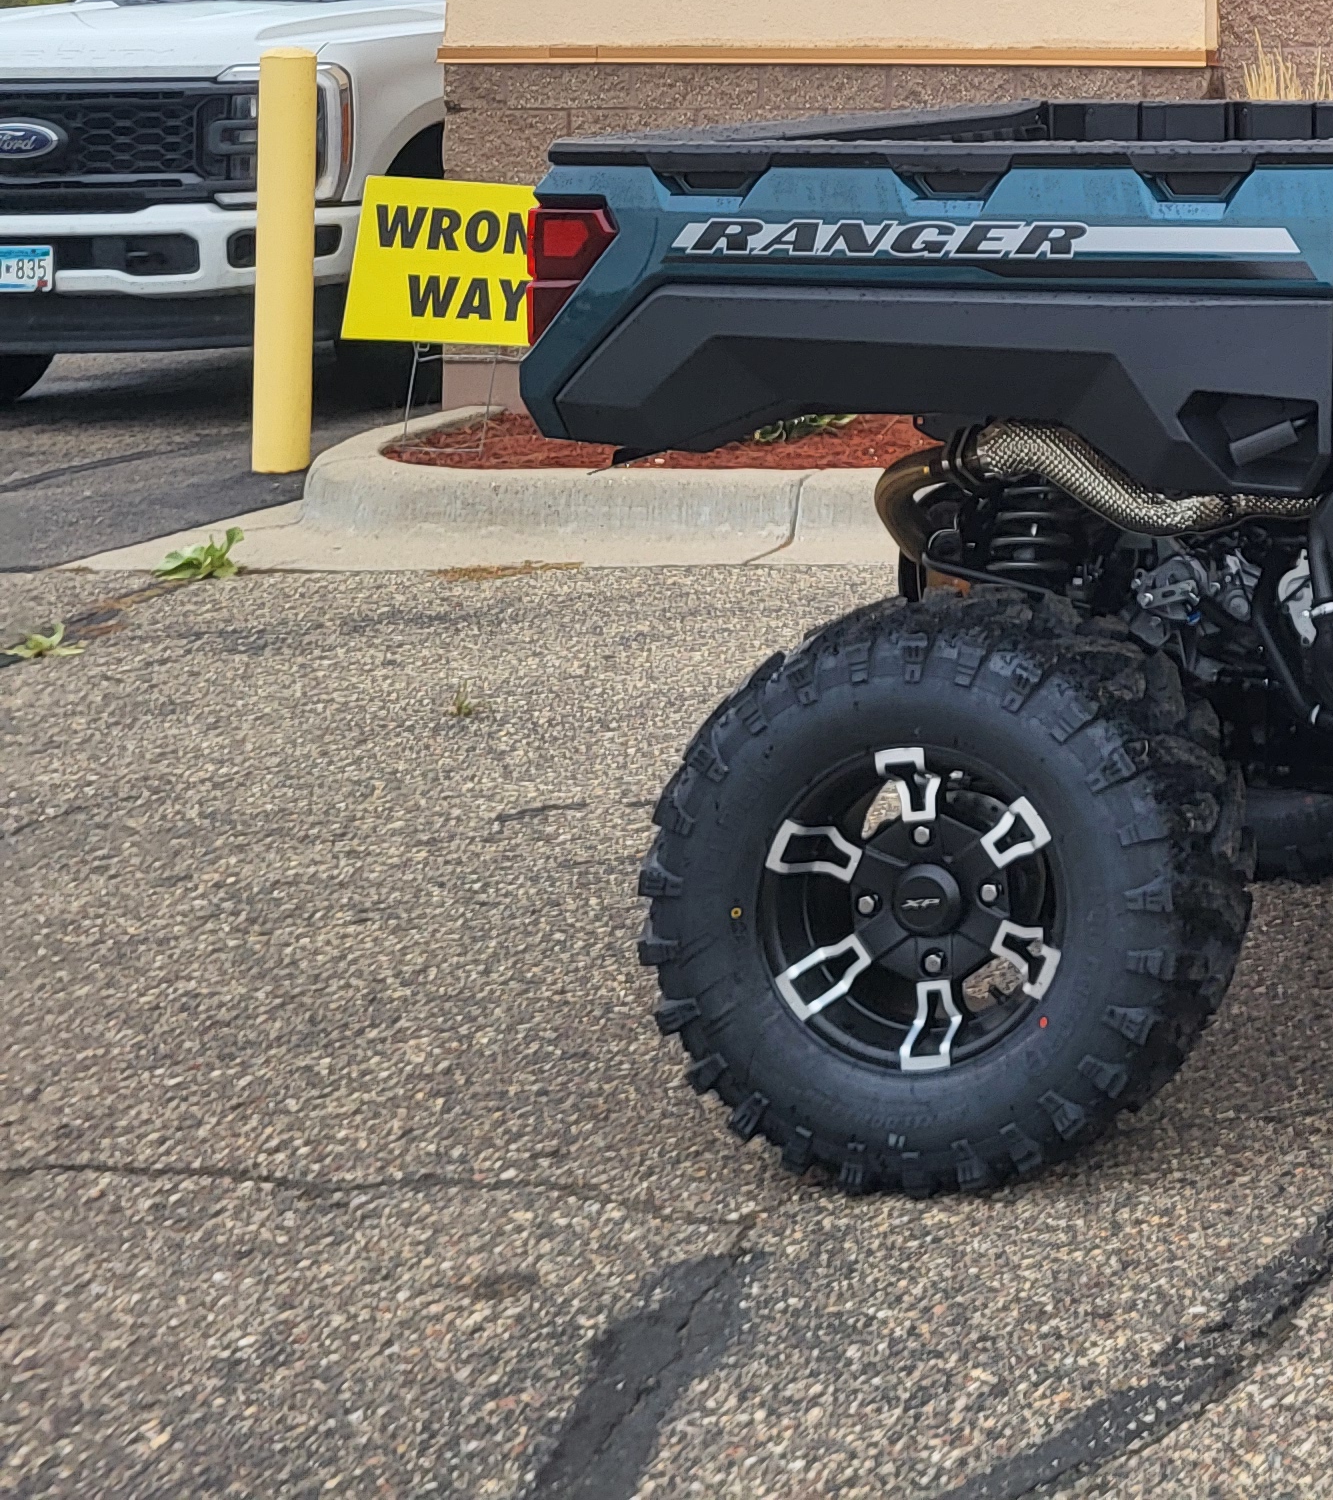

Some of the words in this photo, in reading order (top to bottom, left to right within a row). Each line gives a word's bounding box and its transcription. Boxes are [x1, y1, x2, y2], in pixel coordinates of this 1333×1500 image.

[0, 131, 37, 150] Ford
[376, 203, 527, 255] WRON
[686, 217, 1089, 260] RANGER
[407, 273, 532, 322] WAY
[901, 898, 941, 908] XP
